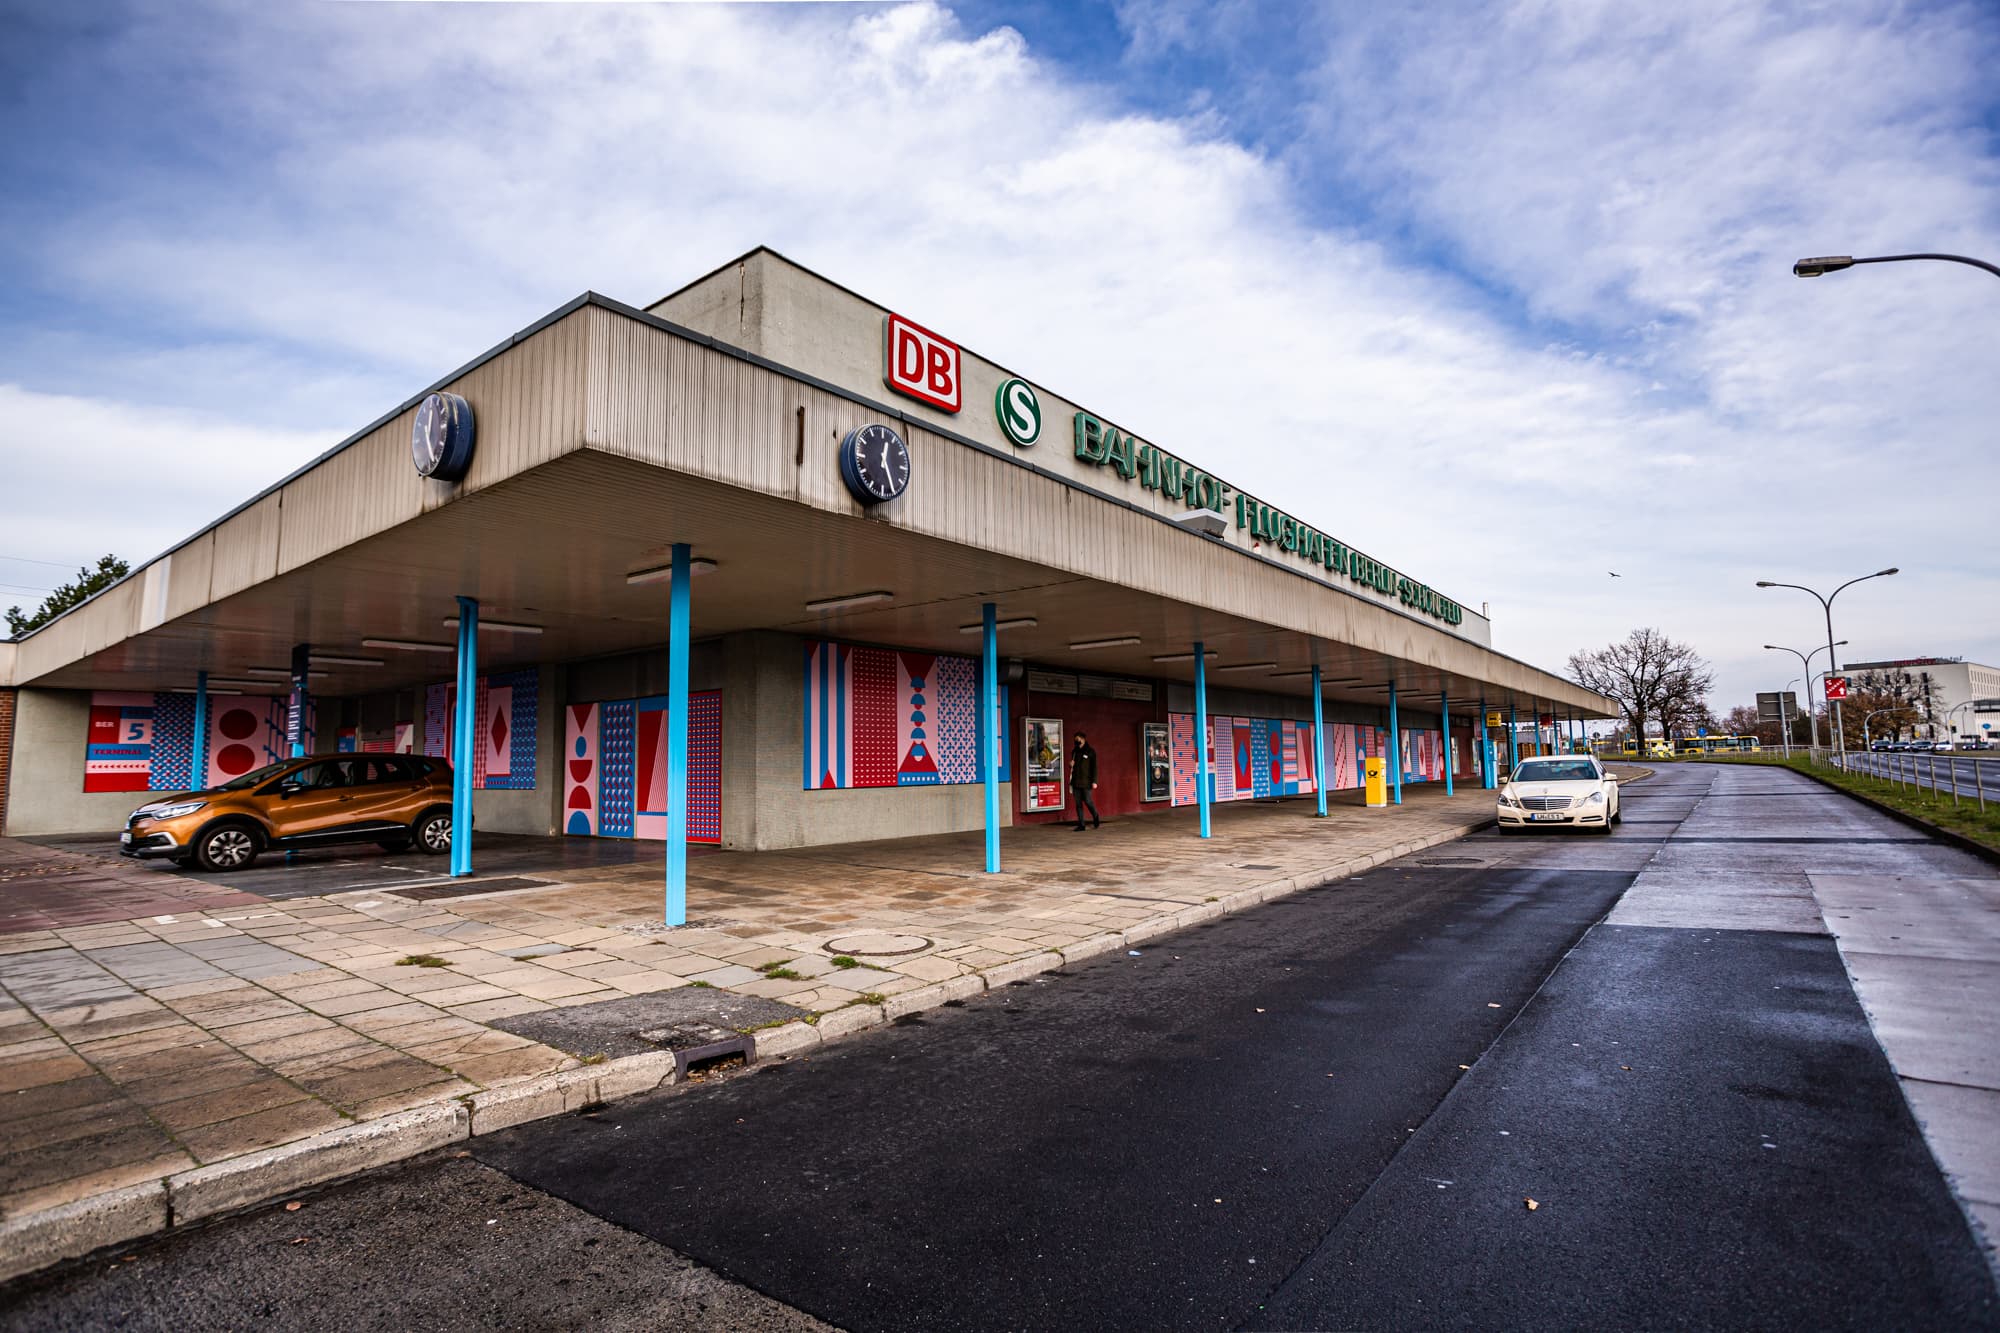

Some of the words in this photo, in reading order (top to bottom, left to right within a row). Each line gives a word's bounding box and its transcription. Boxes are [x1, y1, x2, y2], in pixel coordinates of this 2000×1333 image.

[898, 329, 953, 396] DB
[1009, 383, 1037, 440] S
[1074, 411, 1232, 513] BAHNHOF
[1237, 494, 1349, 574] FLUGHAFEN
[93, 748, 142, 756] TERMINAL
[127, 722, 145, 741] 5
